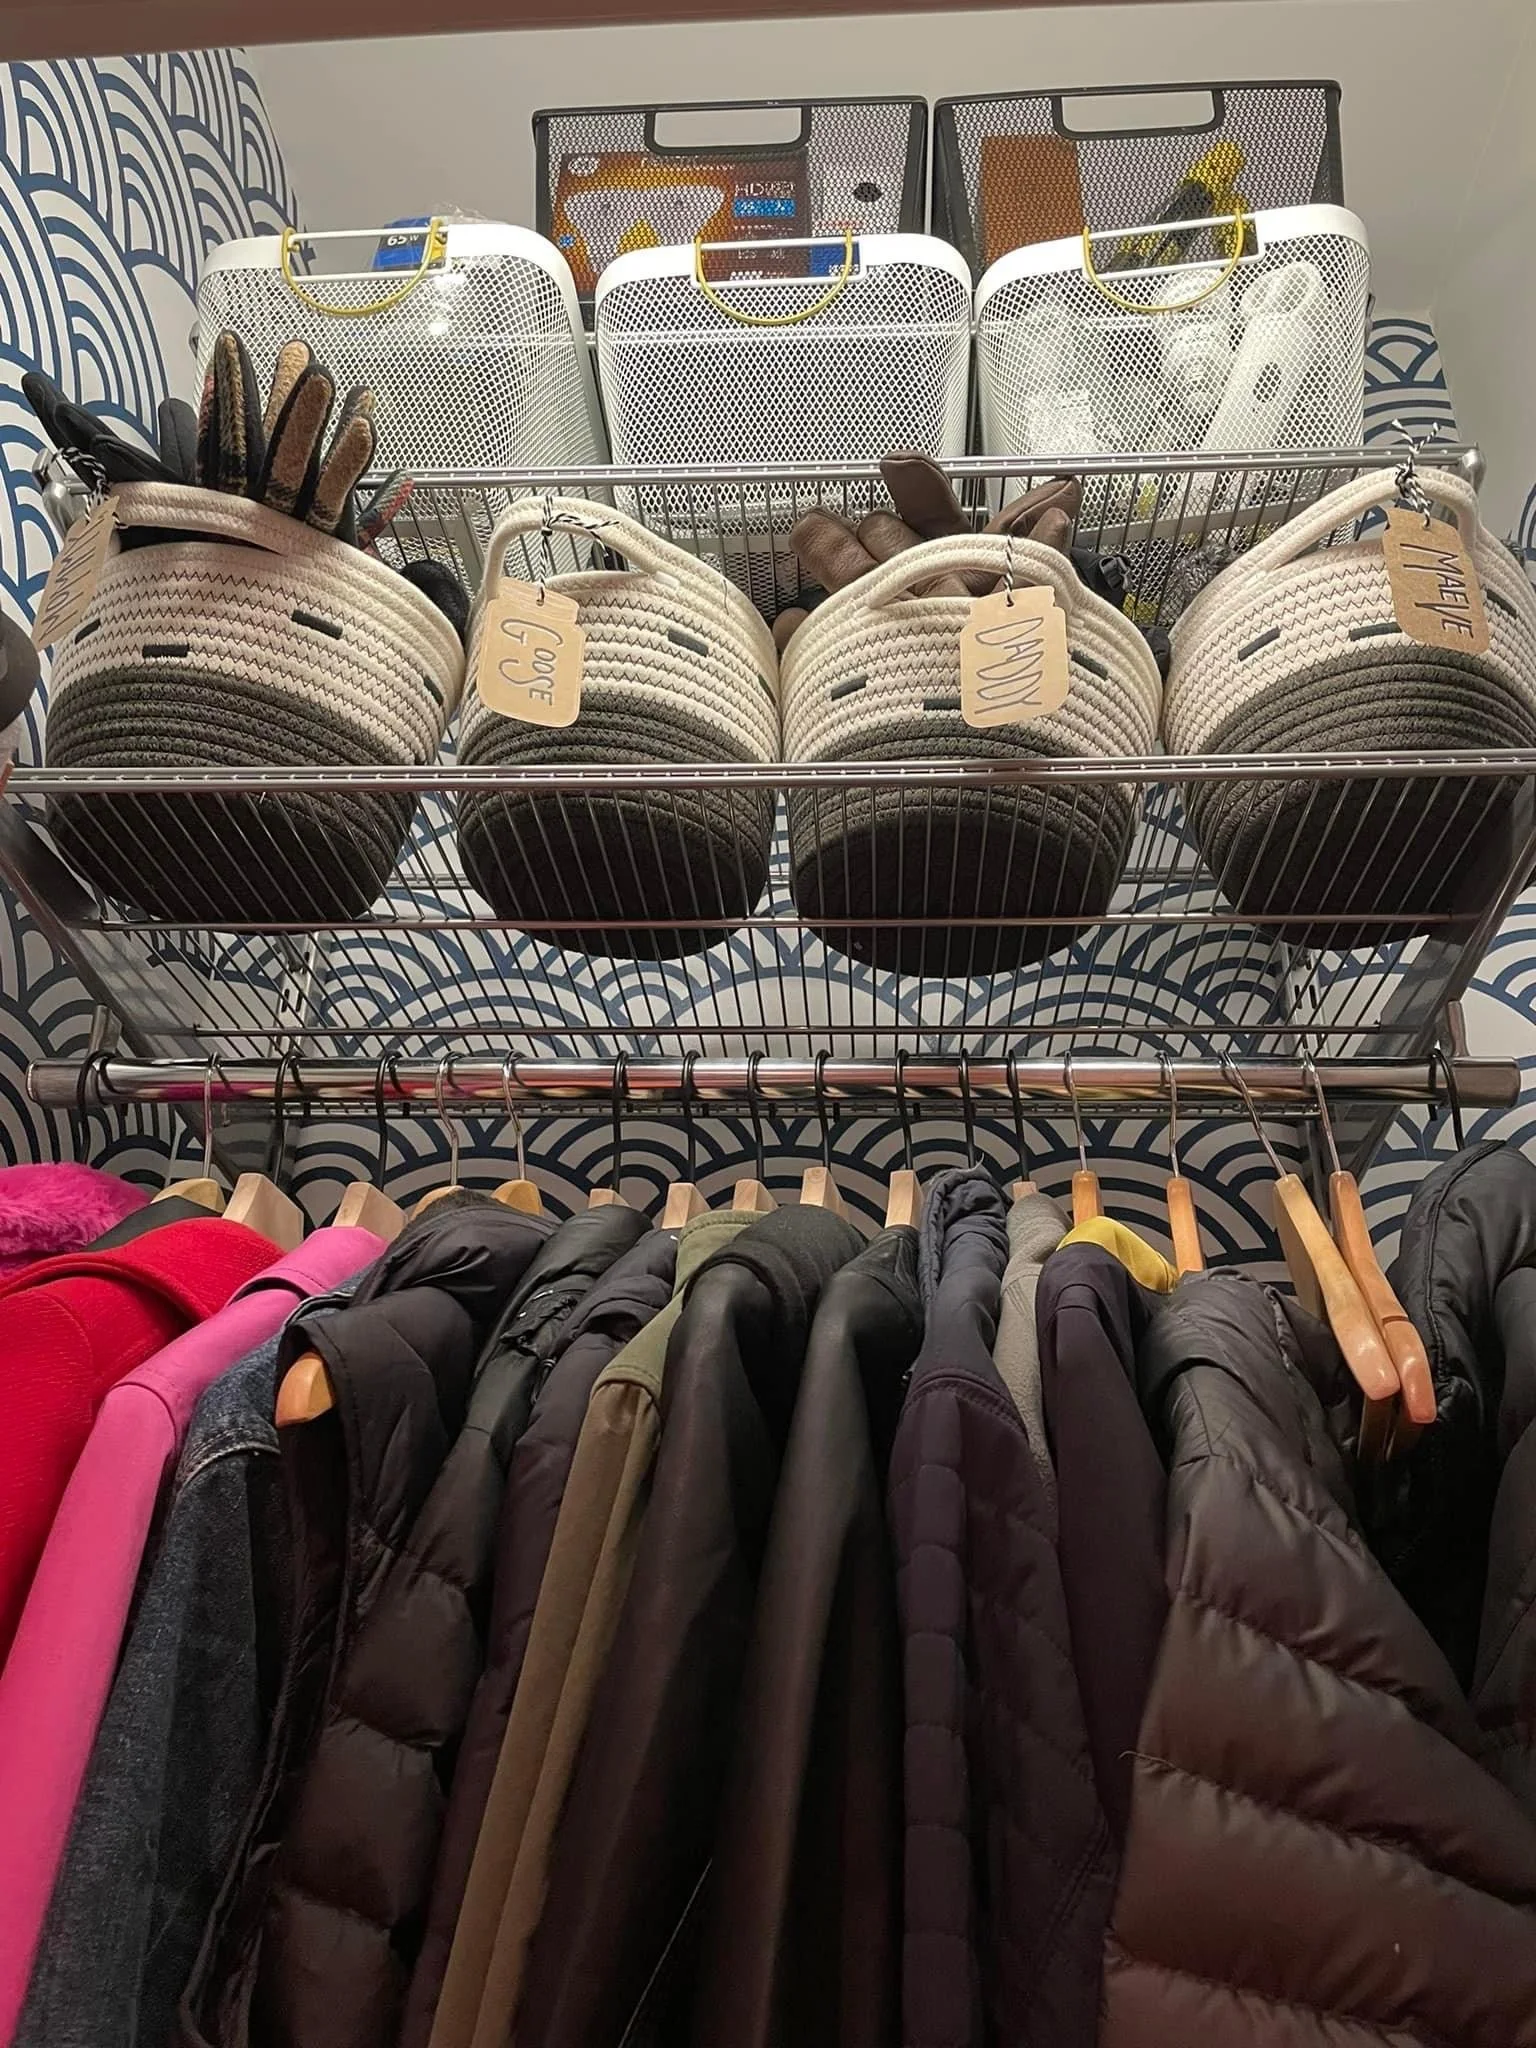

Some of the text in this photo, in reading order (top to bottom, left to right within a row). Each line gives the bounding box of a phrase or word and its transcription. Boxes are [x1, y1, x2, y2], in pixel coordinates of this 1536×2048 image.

[37, 507, 109, 642] MOMMY
[1399, 542, 1475, 640] MAEVE
[498, 618, 564, 706] GOOSE
[973, 616, 1045, 716] DADDY
